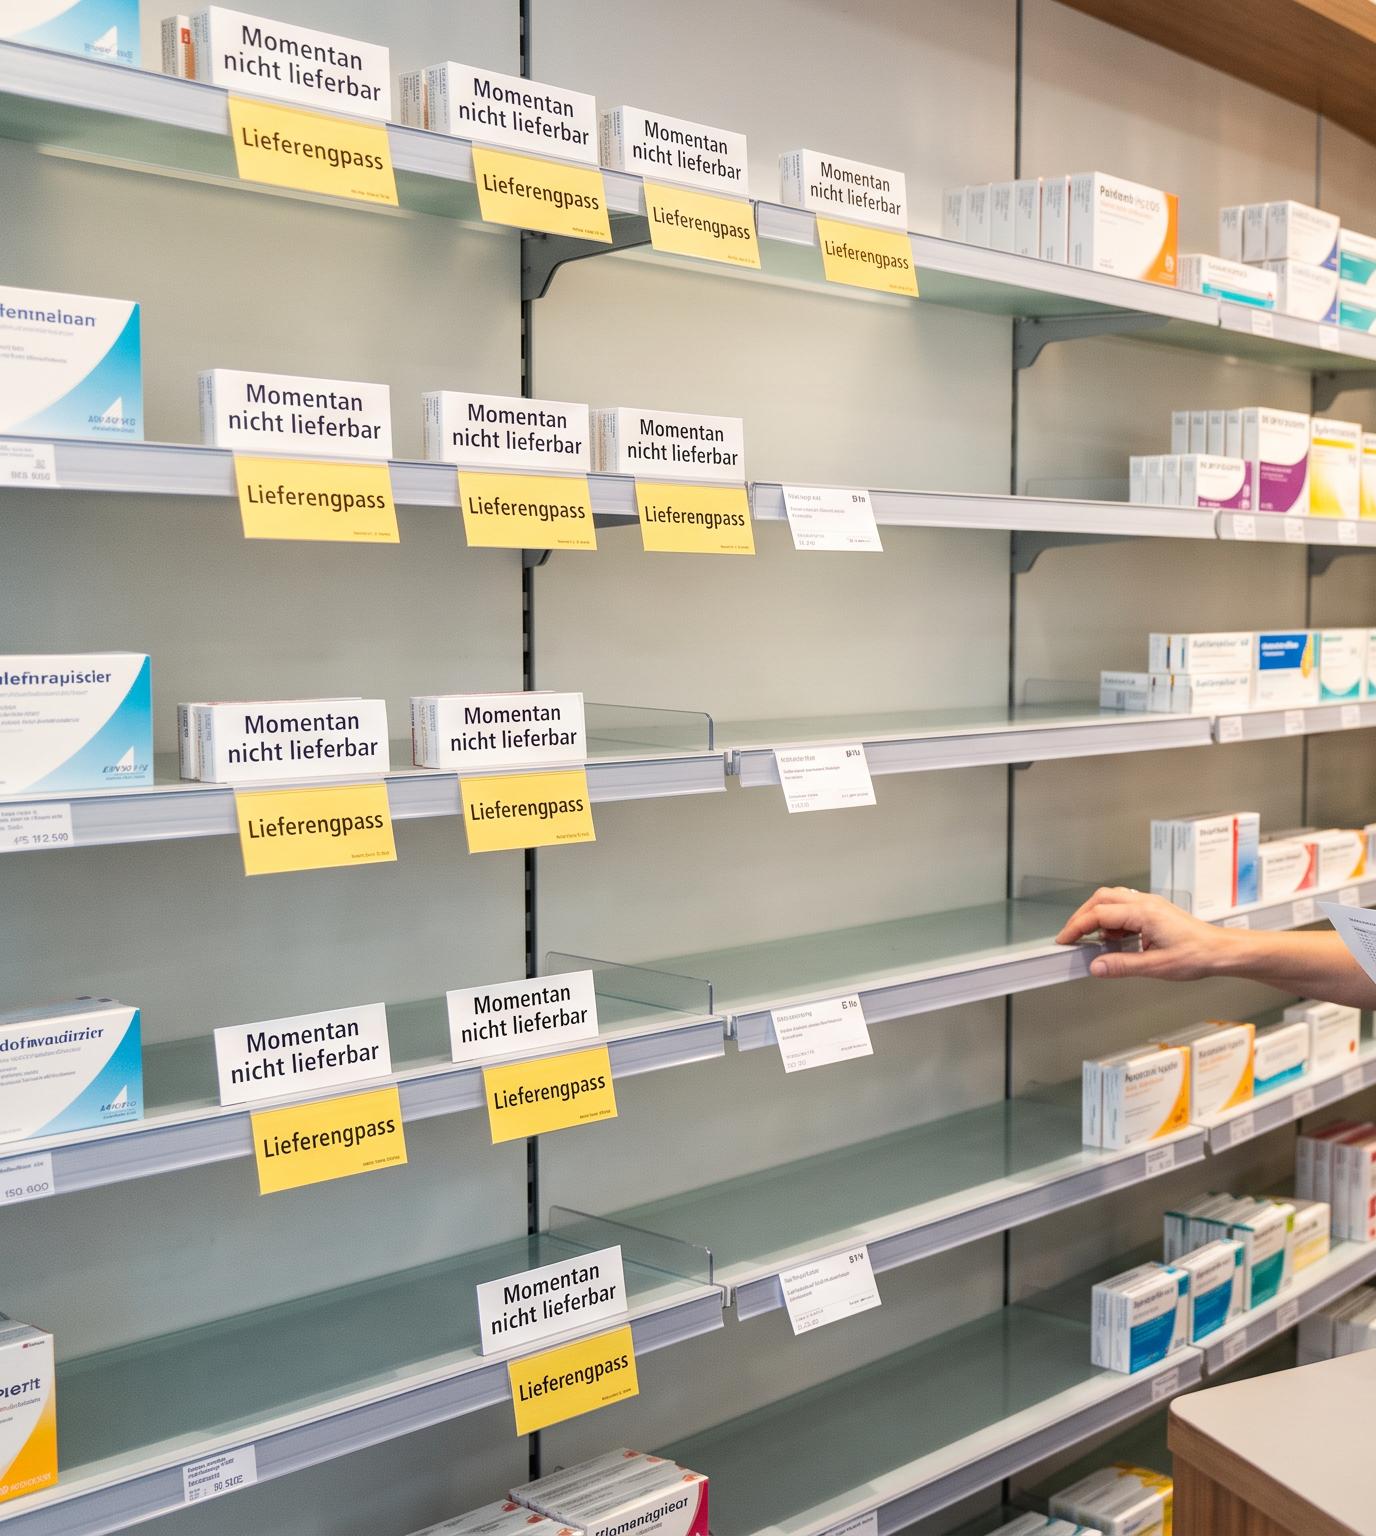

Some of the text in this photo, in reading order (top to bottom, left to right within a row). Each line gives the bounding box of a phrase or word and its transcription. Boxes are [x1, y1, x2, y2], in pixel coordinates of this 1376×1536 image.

[242, 25, 363, 70] Momentan
[224, 51, 381, 101] nicht lieferbar
[474, 78, 574, 118] Momentan
[459, 101, 589, 145] nicht lieferbar
[644, 120, 728, 155] Momentan
[242, 127, 383, 170] Lieferengpass
[632, 142, 742, 180] nicht lieferbar
[483, 173, 599, 210] Lieferengpass
[820, 162, 890, 192] Momentan
[810, 181, 901, 215] nicht lieferbar
[653, 206, 751, 240] Lieferengpass
[825, 240, 909, 270] Lieferengpass
[246, 383, 363, 411] Momentan
[229, 409, 381, 440] nicht lieferbar
[467, 403, 567, 428] Momentan
[639, 419, 724, 441] Momentan
[452, 427, 582, 455] nicht lieferbar
[627, 441, 739, 466] nicht lieferbar
[247, 484, 385, 513] Lieferengpass
[468, 496, 586, 522] Lieferengpass
[644, 505, 745, 530] Lieferengpass
[245, 712, 359, 734] Momentan
[464, 704, 560, 725] Momentan
[228, 736, 378, 764] nicht lieferbar
[450, 727, 577, 752] nicht lieferbar
[470, 799, 584, 821] Lieferengpass
[248, 814, 384, 839] Lieferengpass
[474, 985, 570, 1015] Momentan
[246, 1021, 359, 1054] Momentan
[461, 1007, 588, 1044] nicht lieferbar
[231, 1044, 379, 1084] nicht lieferbar
[494, 1075, 606, 1110] Lieferengpass
[263, 1119, 395, 1158] Lieferengpass
[503, 1264, 600, 1305] Momentan
[491, 1285, 617, 1335] nicht lieferbar
[519, 1350, 629, 1402] Lieferengpass
